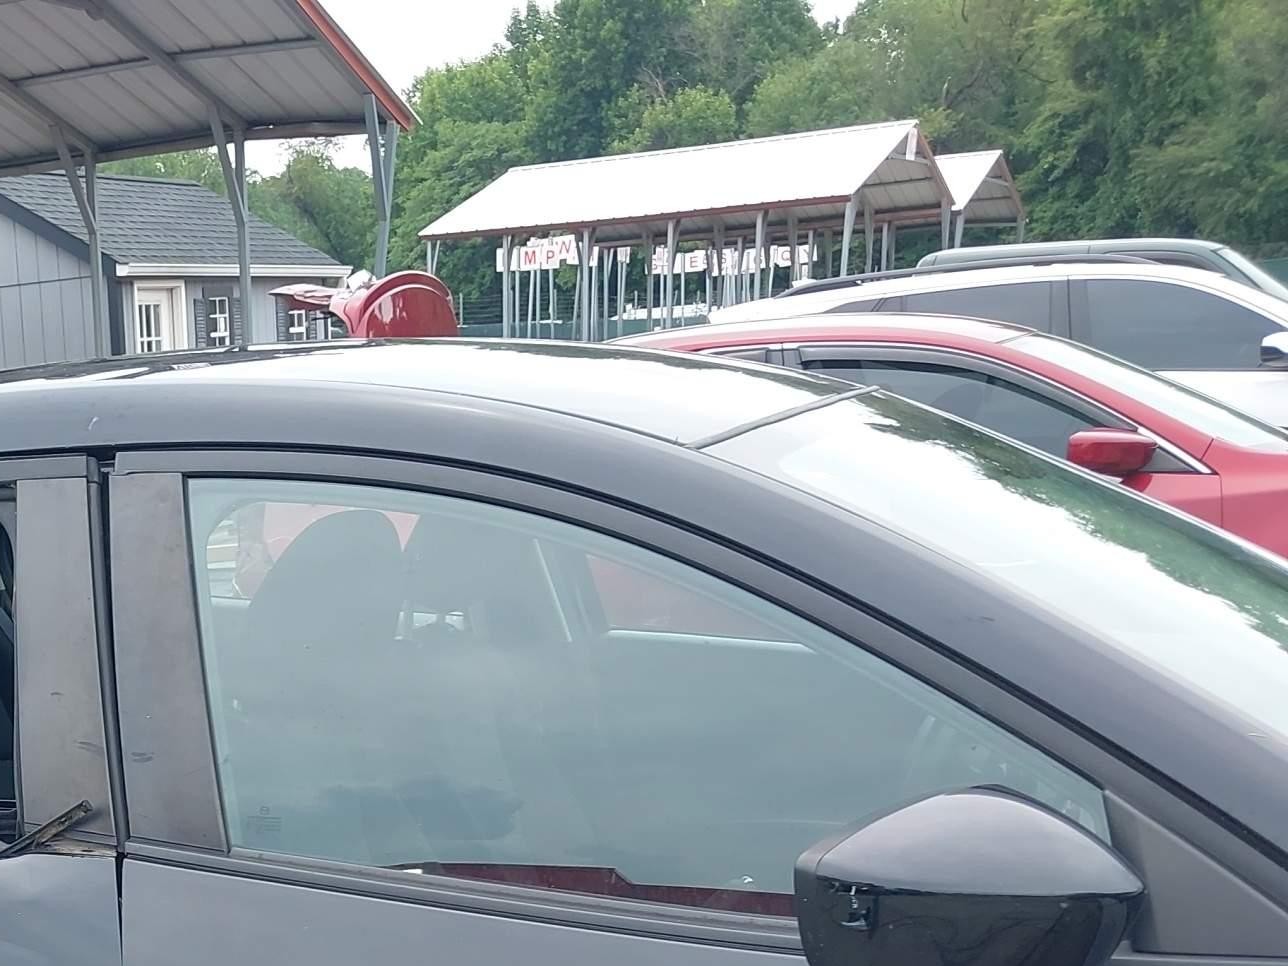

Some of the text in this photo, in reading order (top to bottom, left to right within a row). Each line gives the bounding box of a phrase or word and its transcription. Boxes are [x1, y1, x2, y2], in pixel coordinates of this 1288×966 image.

[523, 250, 537, 265] M
[546, 250, 556, 265] P
[689, 255, 698, 269] E
